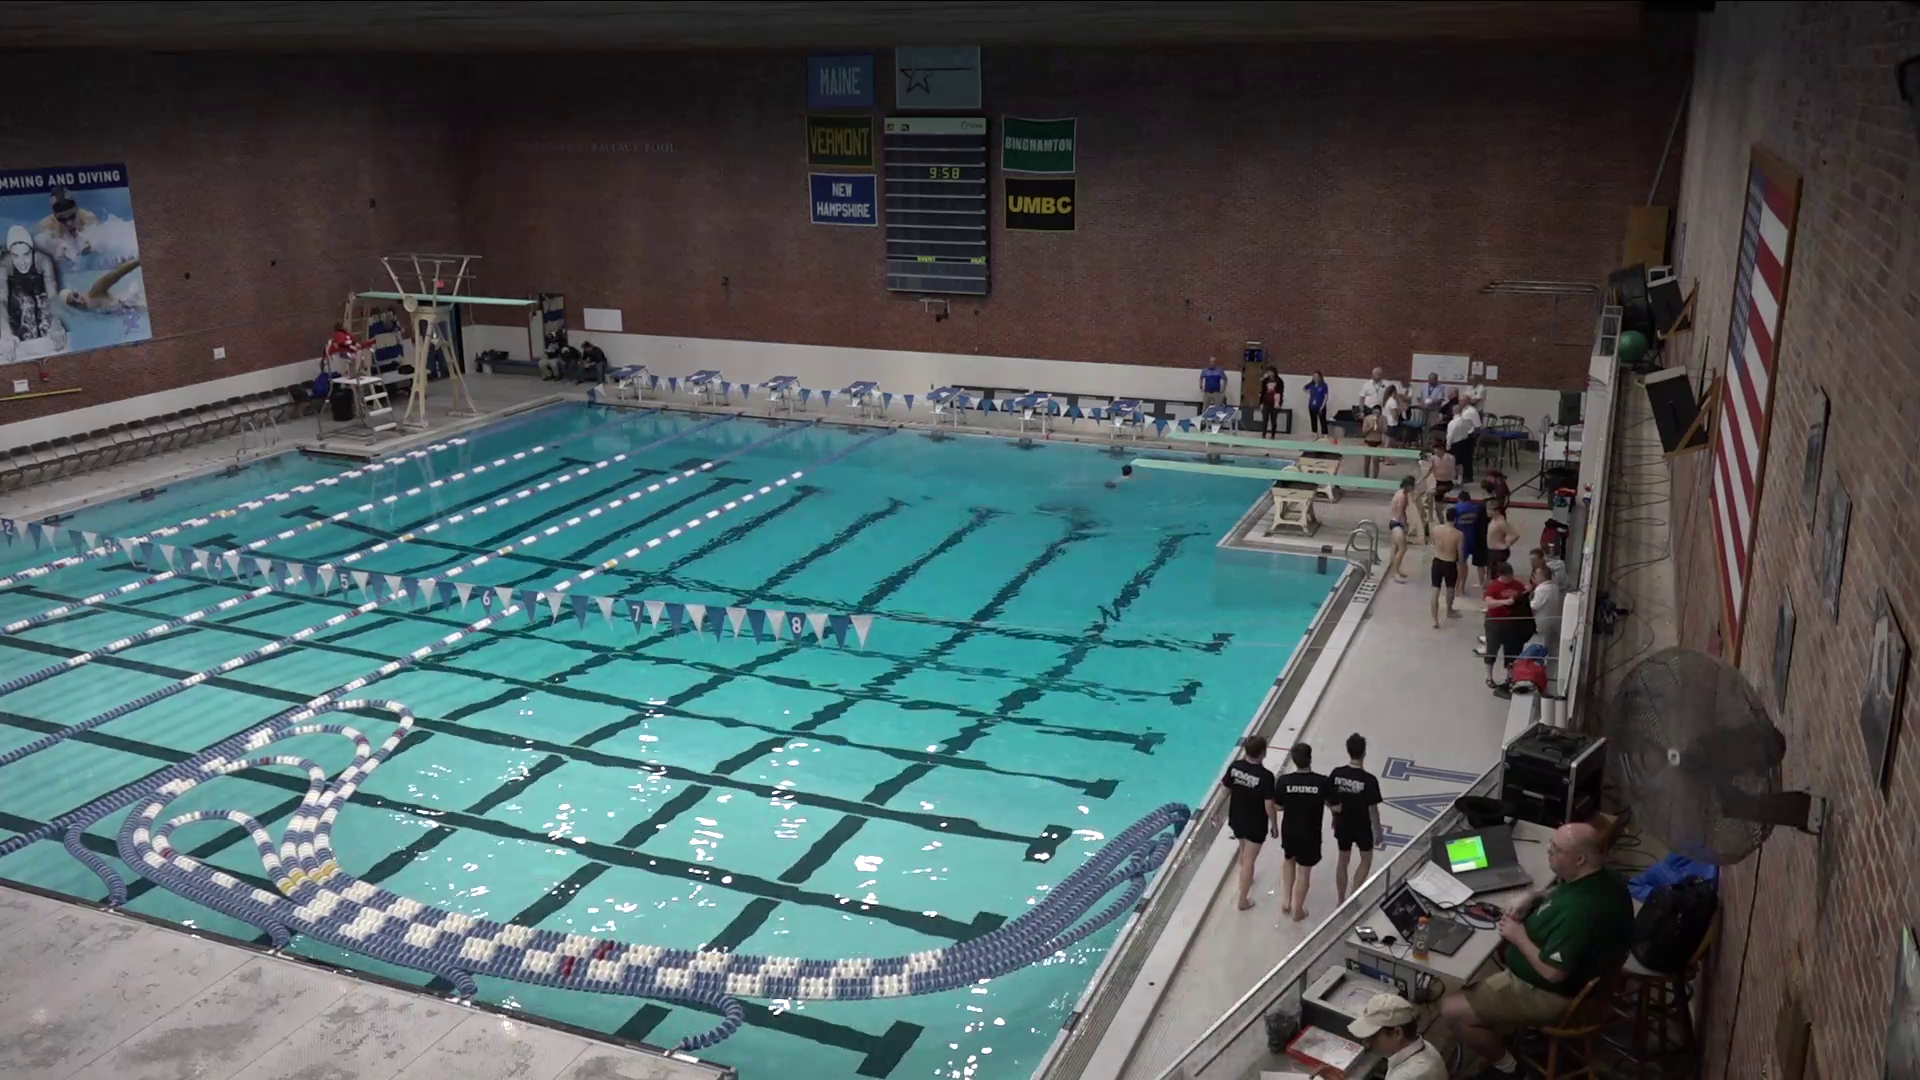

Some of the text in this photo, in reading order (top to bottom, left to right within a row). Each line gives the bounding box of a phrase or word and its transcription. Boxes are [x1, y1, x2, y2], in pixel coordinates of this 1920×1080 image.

[819, 67, 861, 96] MAINE
[810, 127, 870, 155] VERMONT
[1004, 136, 1073, 151] BINGHAMTON
[48, 173, 75, 187] AND
[78, 170, 121, 185] DIVING
[929, 167, 960, 180] 9:58
[832, 182, 852, 198] NEW
[816, 203, 871, 219] HAMPSHIRE
[1008, 195, 1072, 215] UMBC
[5, 521, 14, 536] 2
[105, 539, 113, 554] 3
[214, 556, 222, 571] 4
[339, 573, 349, 589] 5
[482, 590, 491, 606] 6
[632, 605, 641, 622] 7
[791, 618, 801, 634] 8
